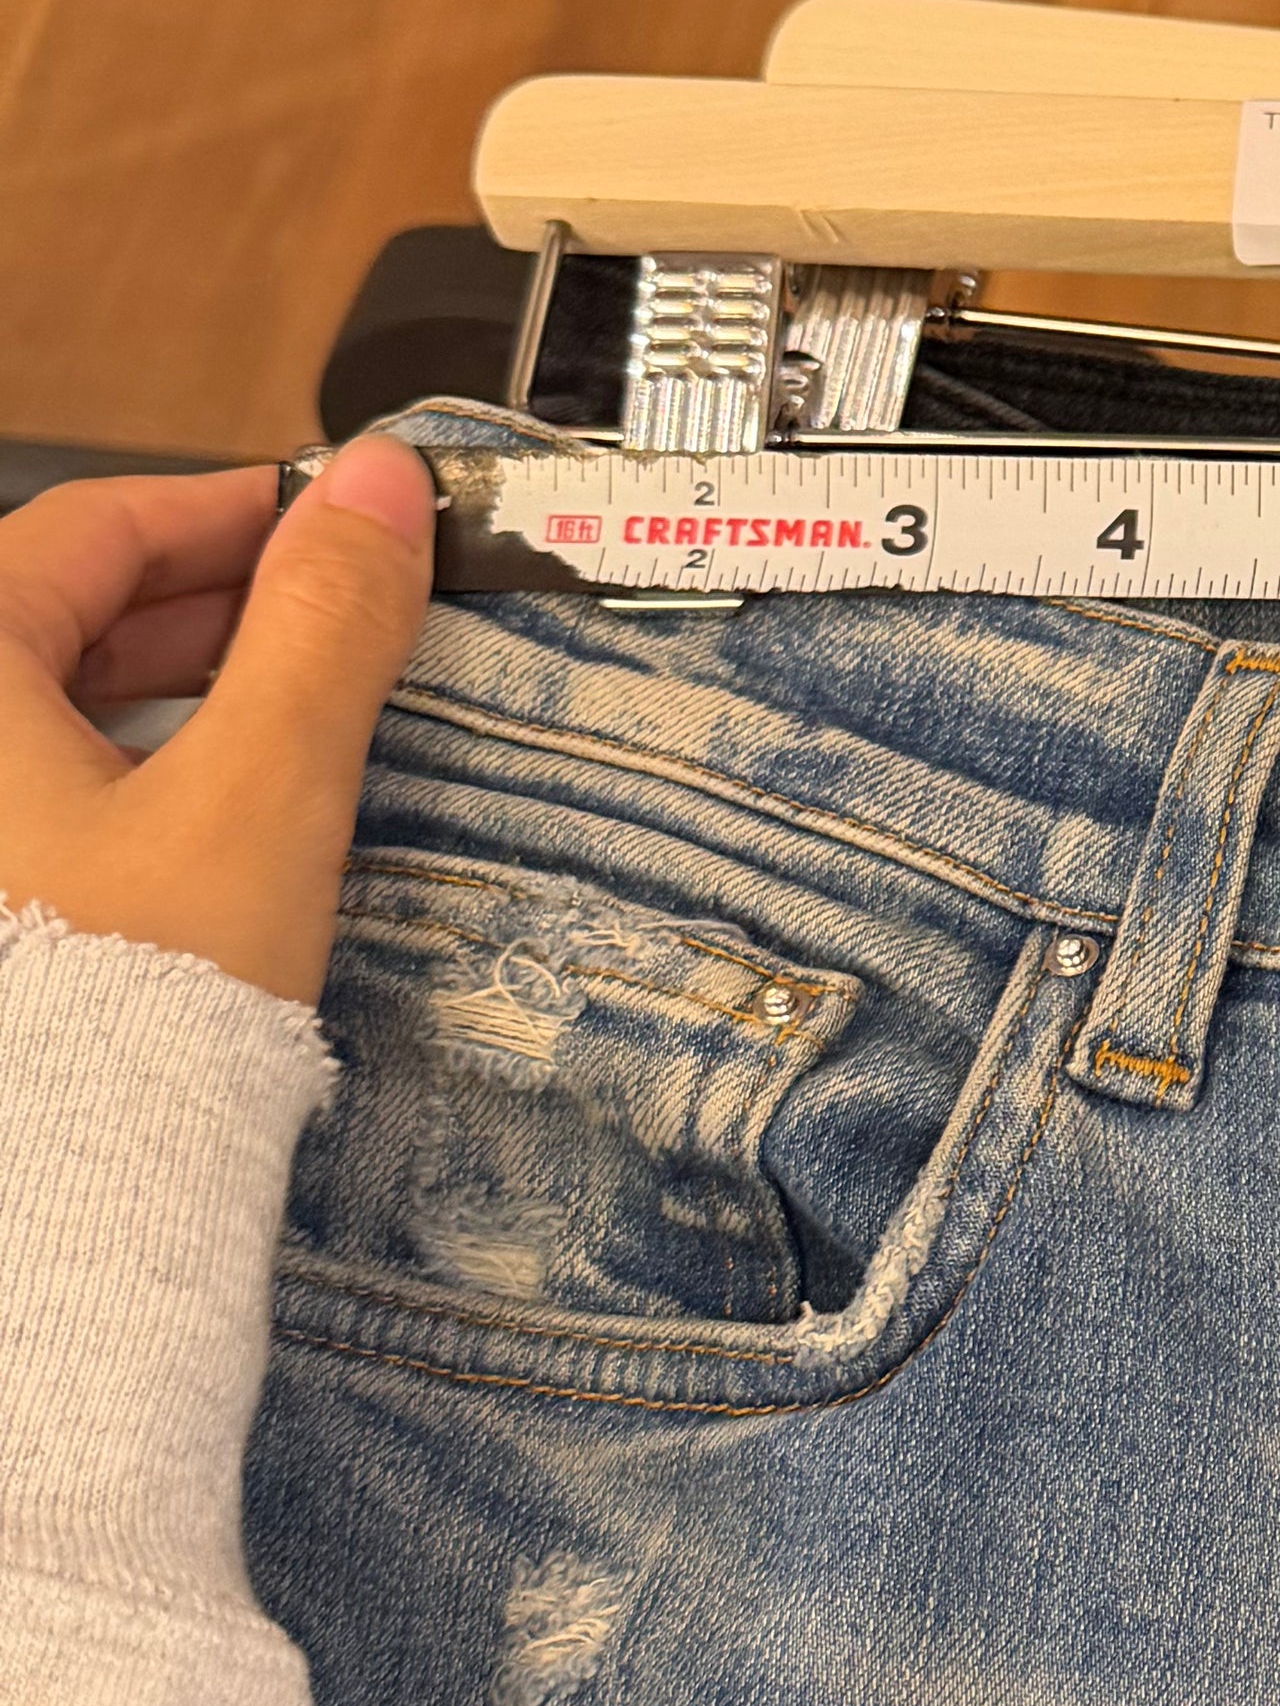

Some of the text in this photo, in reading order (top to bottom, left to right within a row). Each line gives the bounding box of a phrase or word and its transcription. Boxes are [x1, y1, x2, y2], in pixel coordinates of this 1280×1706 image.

[694, 481, 715, 506] 2
[880, 505, 930, 557] 3
[1096, 509, 1145, 560] 4
[684, 549, 708, 570] 2
